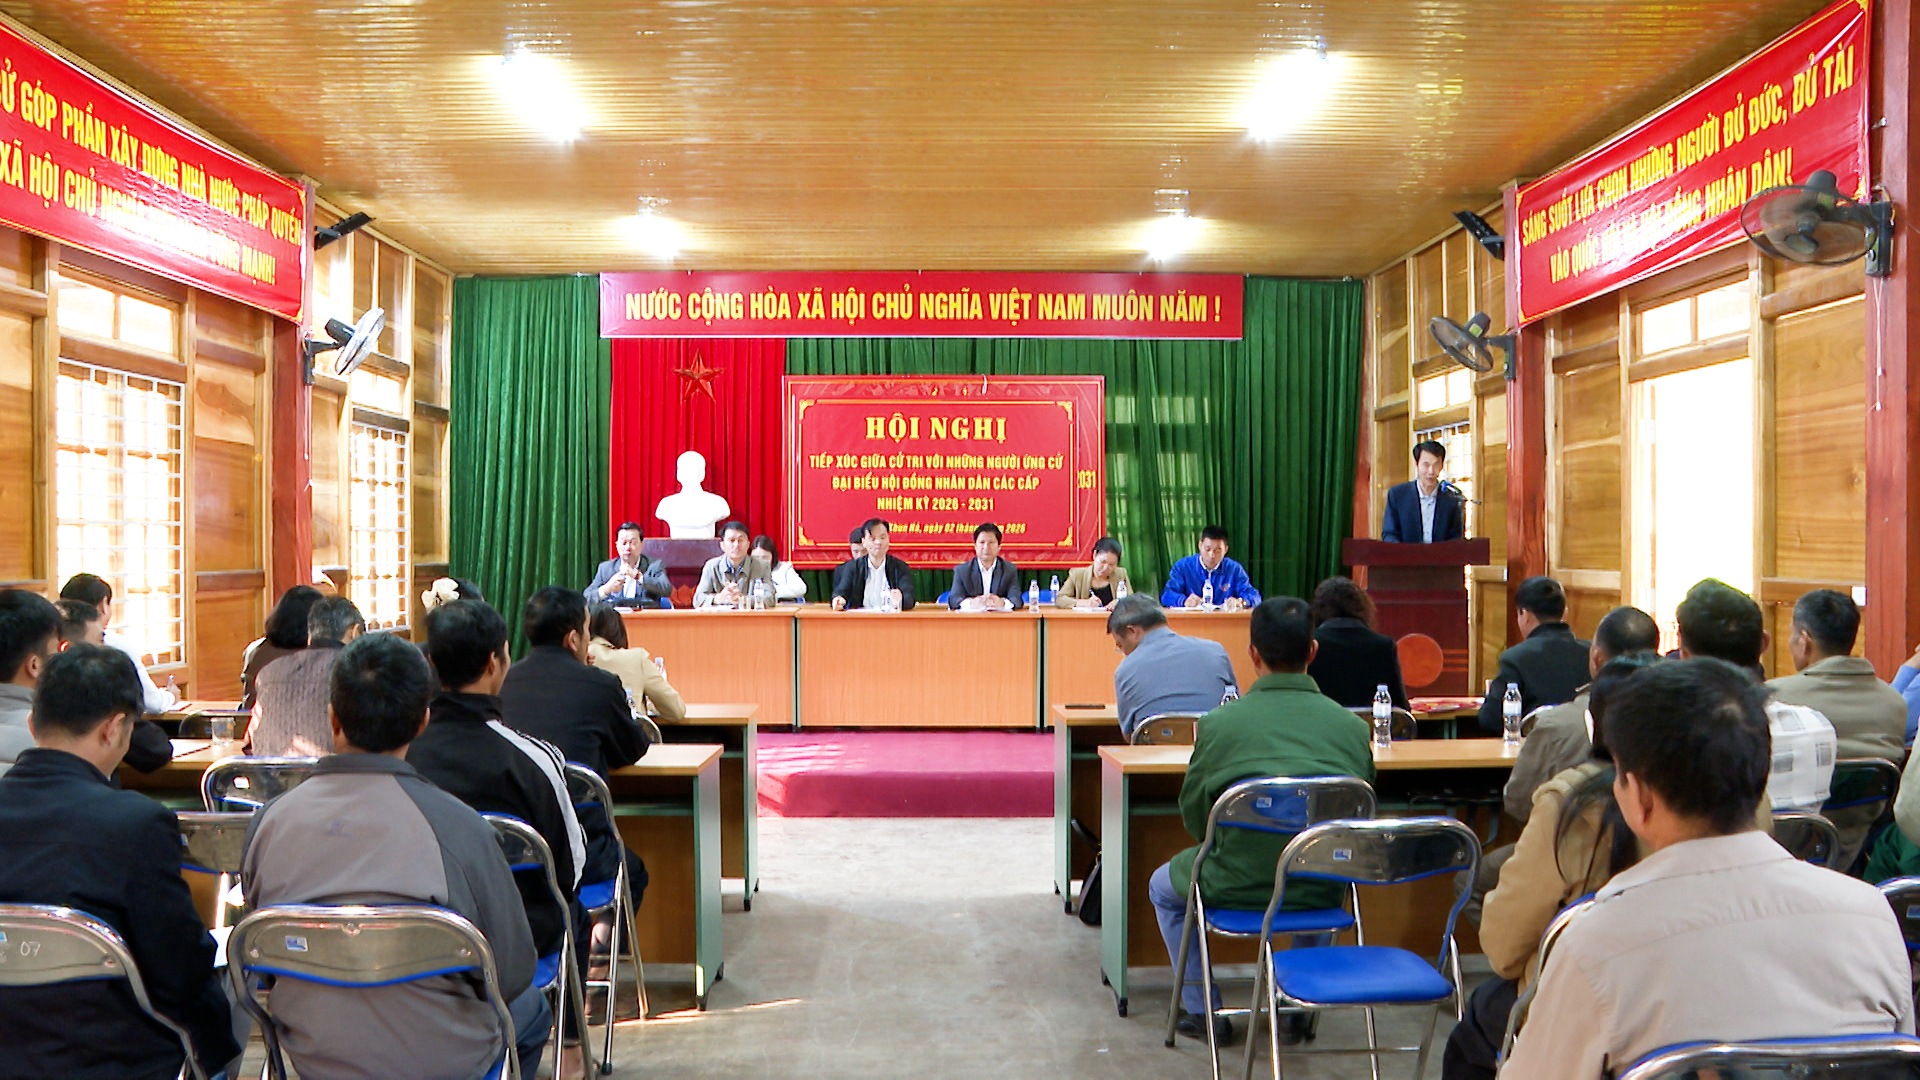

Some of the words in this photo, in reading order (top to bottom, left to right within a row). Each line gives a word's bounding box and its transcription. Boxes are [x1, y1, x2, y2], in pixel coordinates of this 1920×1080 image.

[0, 58, 17, 114] Ử
[20, 79, 58, 132] GÓP
[62, 101, 107, 158] PHẦN
[109, 124, 138, 171] XÂY
[181, 163, 207, 203] NHÀ
[209, 175, 240, 218] NƯỚC
[242, 191, 270, 230] PHÁP
[1522, 209, 1547, 247] SÁNG
[1549, 187, 1573, 234] SUỐT
[1575, 181, 1596, 226] LỰA
[1597, 166, 1628, 210] CHỌN
[1630, 143, 1674, 194] NHỮNG
[1677, 111, 1719, 171] NGƯỜI
[1723, 92, 1744, 148] ĐỦ
[1748, 82, 1787, 136] ĐỨC,
[1793, 51, 1818, 115] ĐỦ
[1822, 41, 1854, 98] TÀI
[0, 139, 24, 190] XÃ
[28, 152, 60, 208] HỘI
[64, 167, 97, 217] CHỦ
[242, 243, 276, 286] MẠNH!
[1550, 246, 1570, 283] VÀO
[1571, 227, 1600, 277] QUỐC
[1705, 165, 1748, 220] NHÂN
[1751, 146, 1794, 198] DÂN!
[625, 287, 682, 320] NƯỚC
[687, 287, 744, 326] CỘNG
[749, 285, 792, 320] HÒA
[797, 286, 826, 320] XÃ
[831, 286, 866, 325] HỘI
[872, 283, 913, 320] CHỦ
[919, 287, 983, 320] NGHĨA
[988, 287, 1033, 326] VIỆT
[1038, 293, 1086, 321] NAM
[1092, 288, 1154, 322] MUÔN
[1159, 289, 1207, 322] NĂM
[865, 412, 920, 443] HỘI
[929, 416, 1007, 443] NGHỊ
[809, 451, 834, 469] TIẾP
[836, 453, 858, 469] XÚC
[860, 452, 887, 469] GIỮA
[889, 451, 905, 469] CỬ
[906, 455, 924, 469] TRI
[926, 453, 944, 469] VỚI
[946, 453, 984, 469] NHỮNG
[987, 453, 1021, 470] NGƯỜI
[1023, 453, 1046, 470] ỨNG
[1047, 451, 1064, 470] CỬ
[832, 475, 851, 492] ĐẠI
[853, 471, 880, 490] BIỂU
[881, 473, 901, 492] HỘI
[902, 472, 933, 490] ĐỒNG
[935, 474, 966, 490] NHÂN
[968, 474, 991, 490] DÂN
[993, 474, 1016, 490] CÁC
[1017, 473, 1040, 490] CẤP
[1078, 470, 1096, 489] 031
[877, 495, 914, 514] NHIỆM
[915, 496, 930, 510] KỲ
[931, 497, 959, 511] 2026
[968, 497, 994, 511] 2031
[923, 521, 943, 534] ngày
[1005, 522, 1026, 534] 2026
